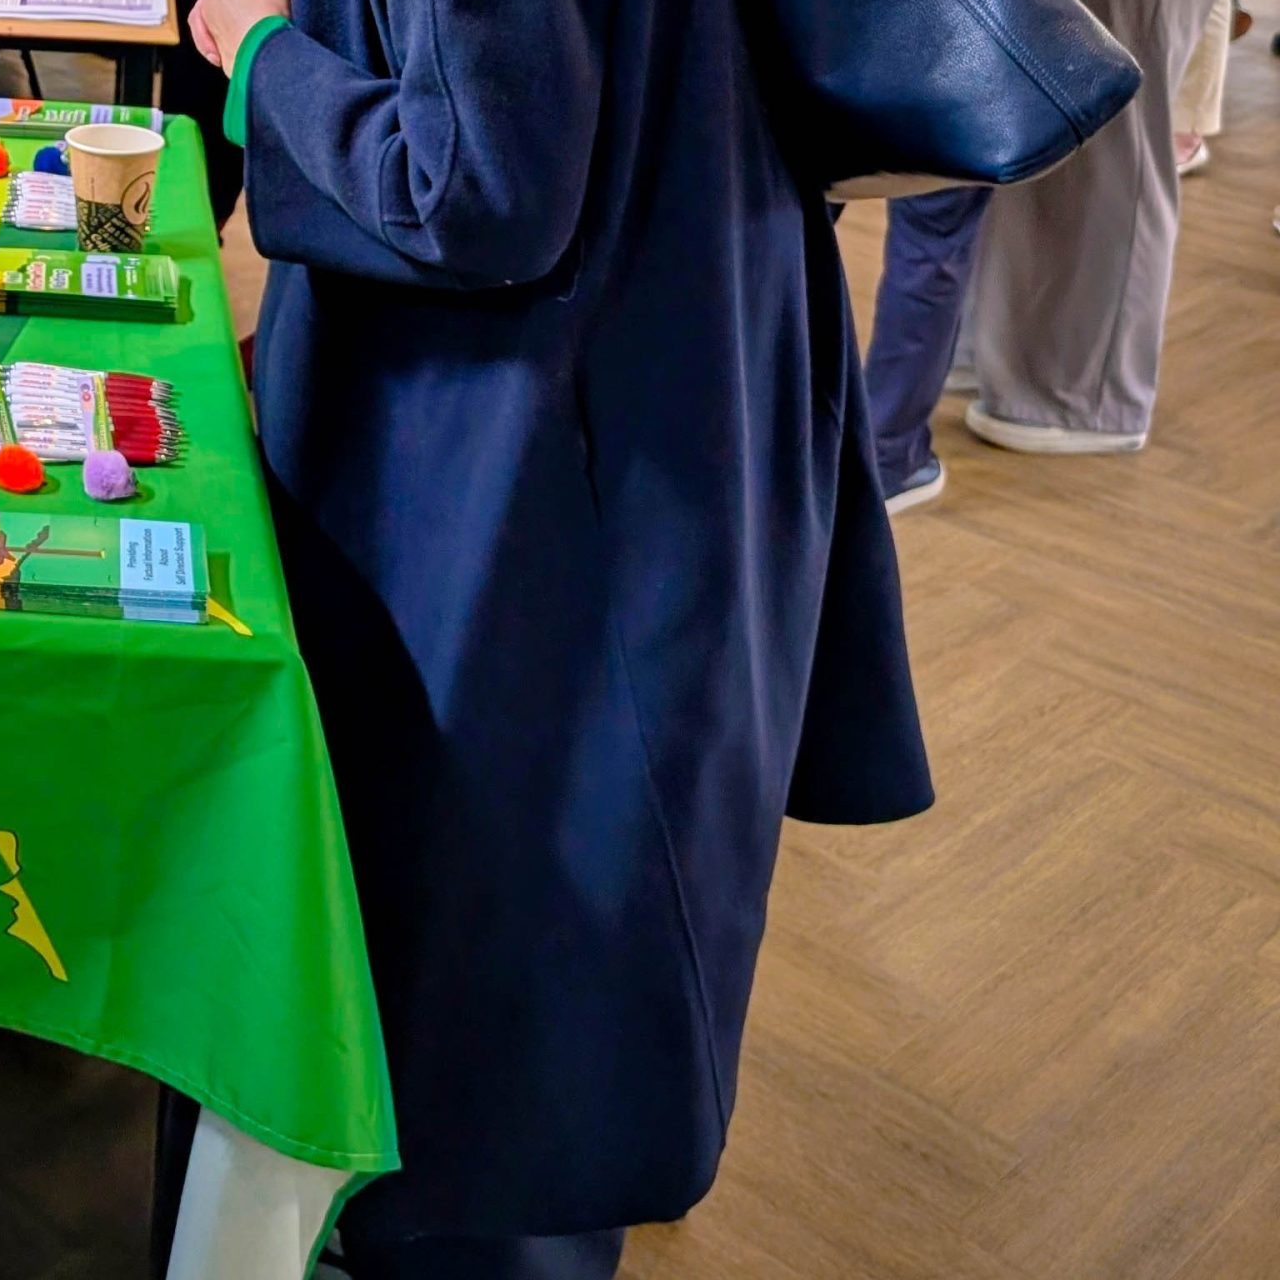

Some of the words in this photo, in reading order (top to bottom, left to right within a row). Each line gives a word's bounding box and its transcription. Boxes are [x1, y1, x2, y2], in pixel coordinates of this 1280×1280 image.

[173, 527, 186, 552] Support
[126, 540, 139, 568] Providing
[158, 548, 169, 567] About
[174, 551, 186, 575] Directed
[143, 561, 154, 581] Factual
[175, 574, 186, 586] Self
